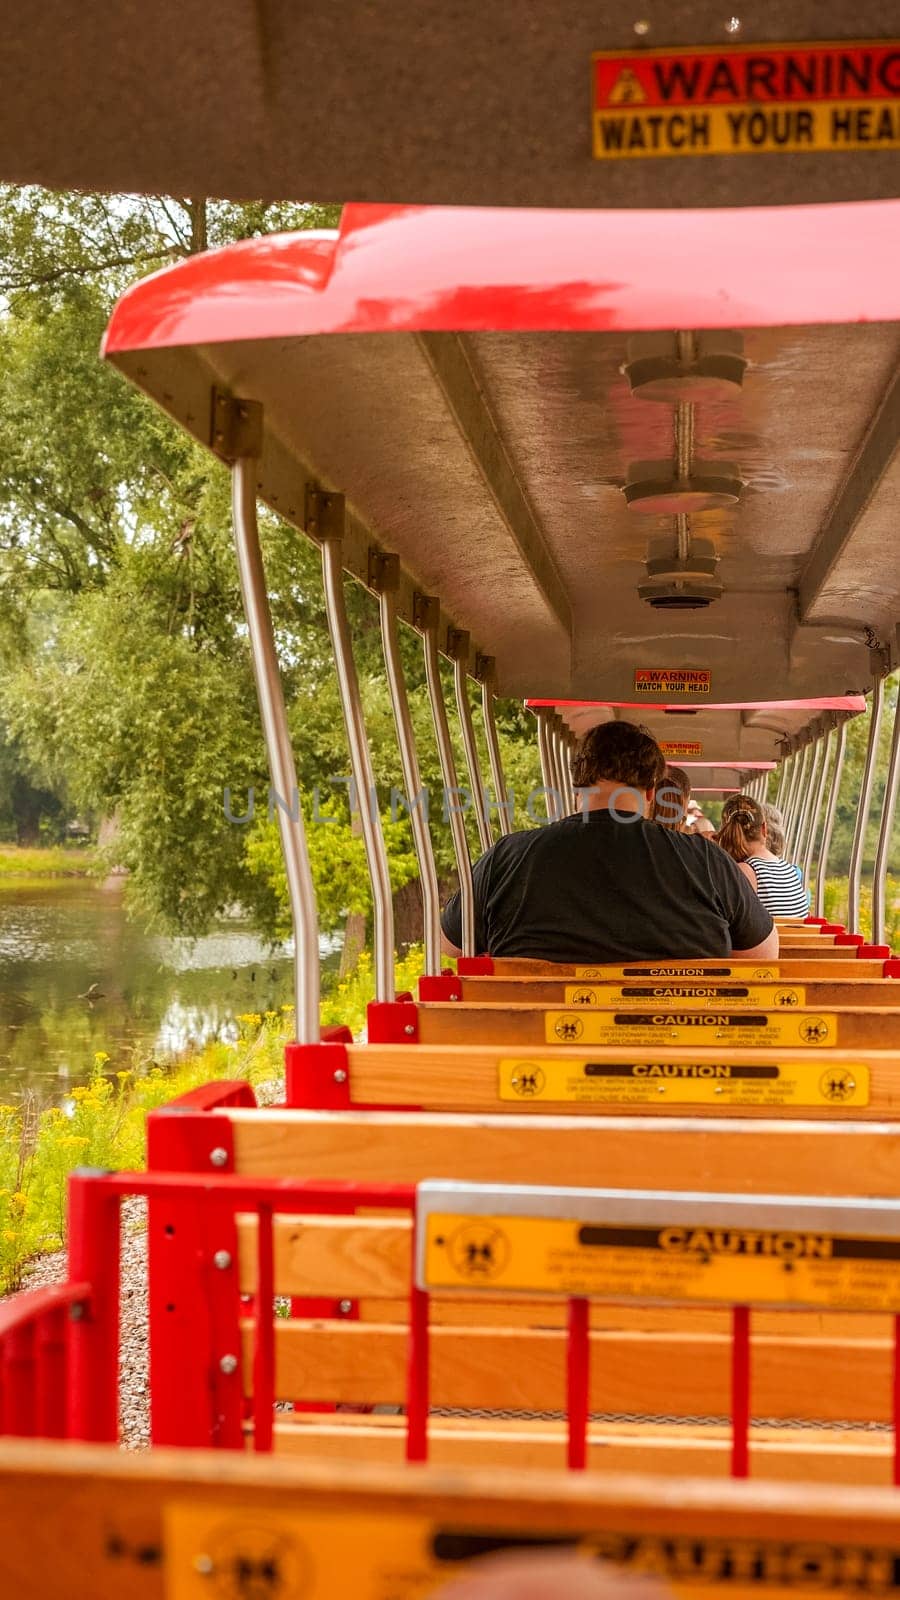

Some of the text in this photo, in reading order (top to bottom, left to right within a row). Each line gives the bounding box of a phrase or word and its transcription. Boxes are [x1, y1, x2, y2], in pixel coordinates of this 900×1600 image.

[599, 107, 900, 151] WATCH YOUR HEA
[650, 671, 708, 682] WARNING
[636, 682, 709, 692] WATCH YOUR HEAD
[649, 968, 704, 976] CAUTION
[653, 988, 717, 997] CAUTION
[652, 1015, 730, 1025] CAUTION
[632, 1064, 730, 1078] CAUTION
[658, 1227, 832, 1258] CAUTION
